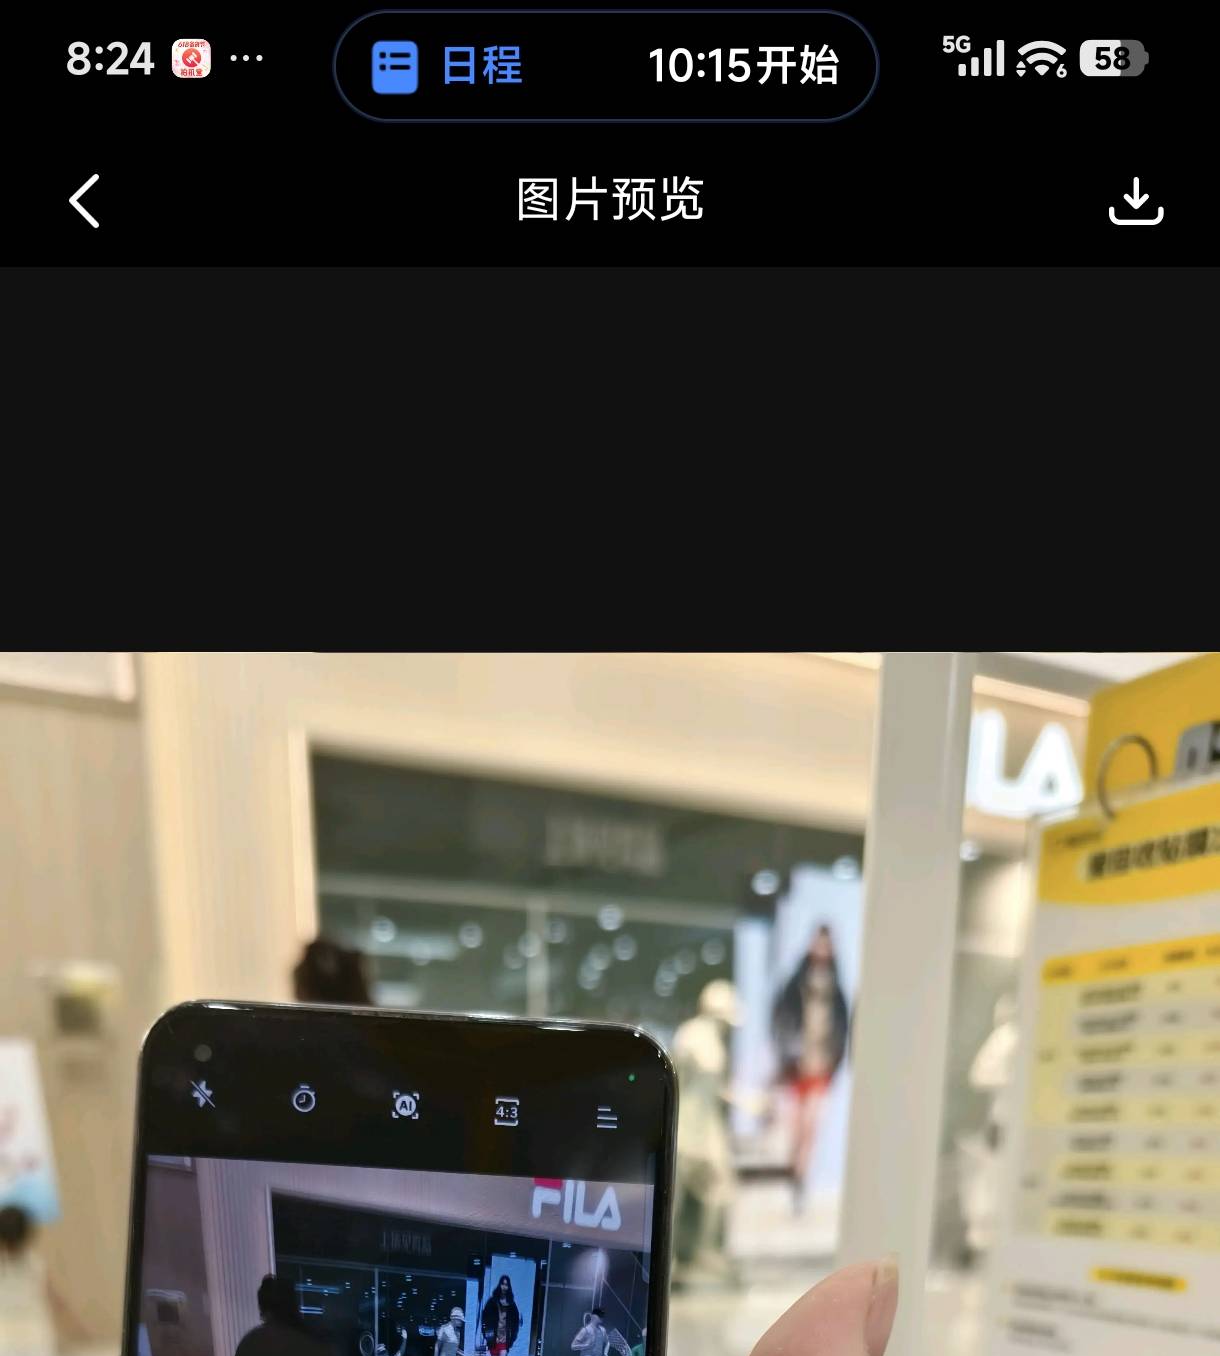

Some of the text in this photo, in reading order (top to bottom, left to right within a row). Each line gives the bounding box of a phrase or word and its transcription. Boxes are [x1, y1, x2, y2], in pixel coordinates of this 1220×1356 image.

[66, 41, 155, 76] 8:24
[942, 34, 971, 54] 5G
[1094, 46, 1131, 71] 58
[444, 45, 523, 85] 日程
[649, 43, 840, 85] 10:15开始
[1056, 63, 1068, 79] 6
[517, 175, 704, 222] 图片预览
[399, 1100, 412, 1111] AI
[495, 1106, 518, 1119] 4:3
[532, 1179, 621, 1231] FILA
